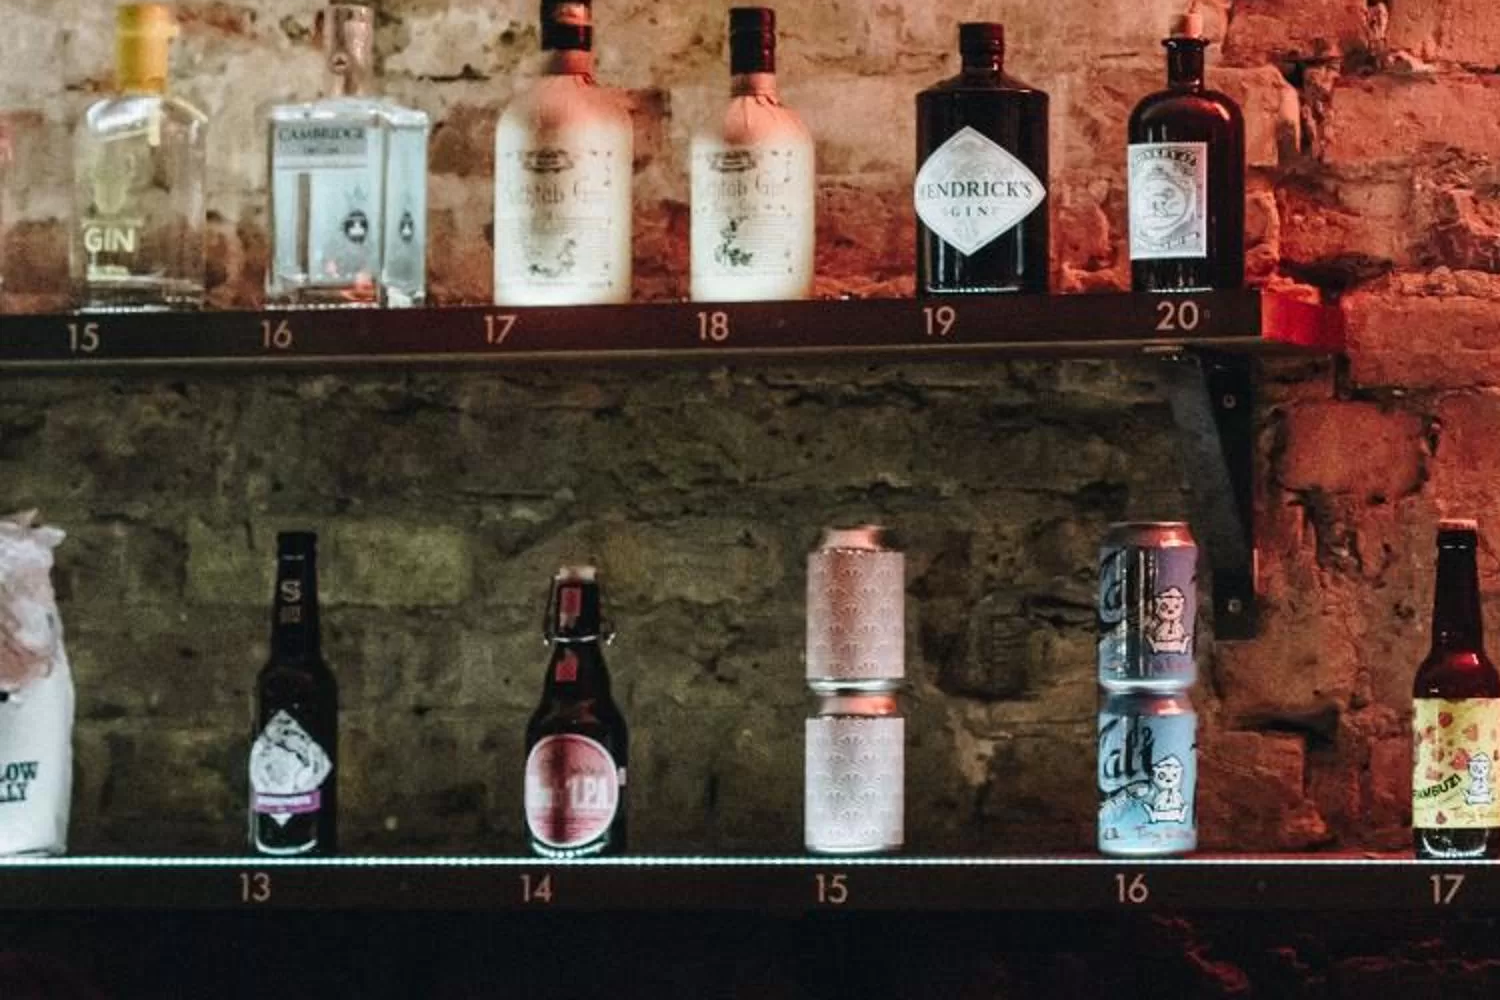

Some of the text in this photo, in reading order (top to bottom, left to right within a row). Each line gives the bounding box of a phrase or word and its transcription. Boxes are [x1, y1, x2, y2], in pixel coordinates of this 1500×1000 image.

[83, 226, 136, 253] GIN
[484, 314, 517, 343] 17
[697, 311, 729, 341] 18
[923, 305, 956, 335] 19
[1157, 300, 1199, 330] 20
[67, 322, 100, 353] 15
[261, 319, 293, 349] 16
[240, 871, 271, 902] 13
[521, 874, 552, 902] 14
[816, 873, 848, 904] 15
[1115, 873, 1149, 903] 16
[1430, 873, 1465, 904] 17
